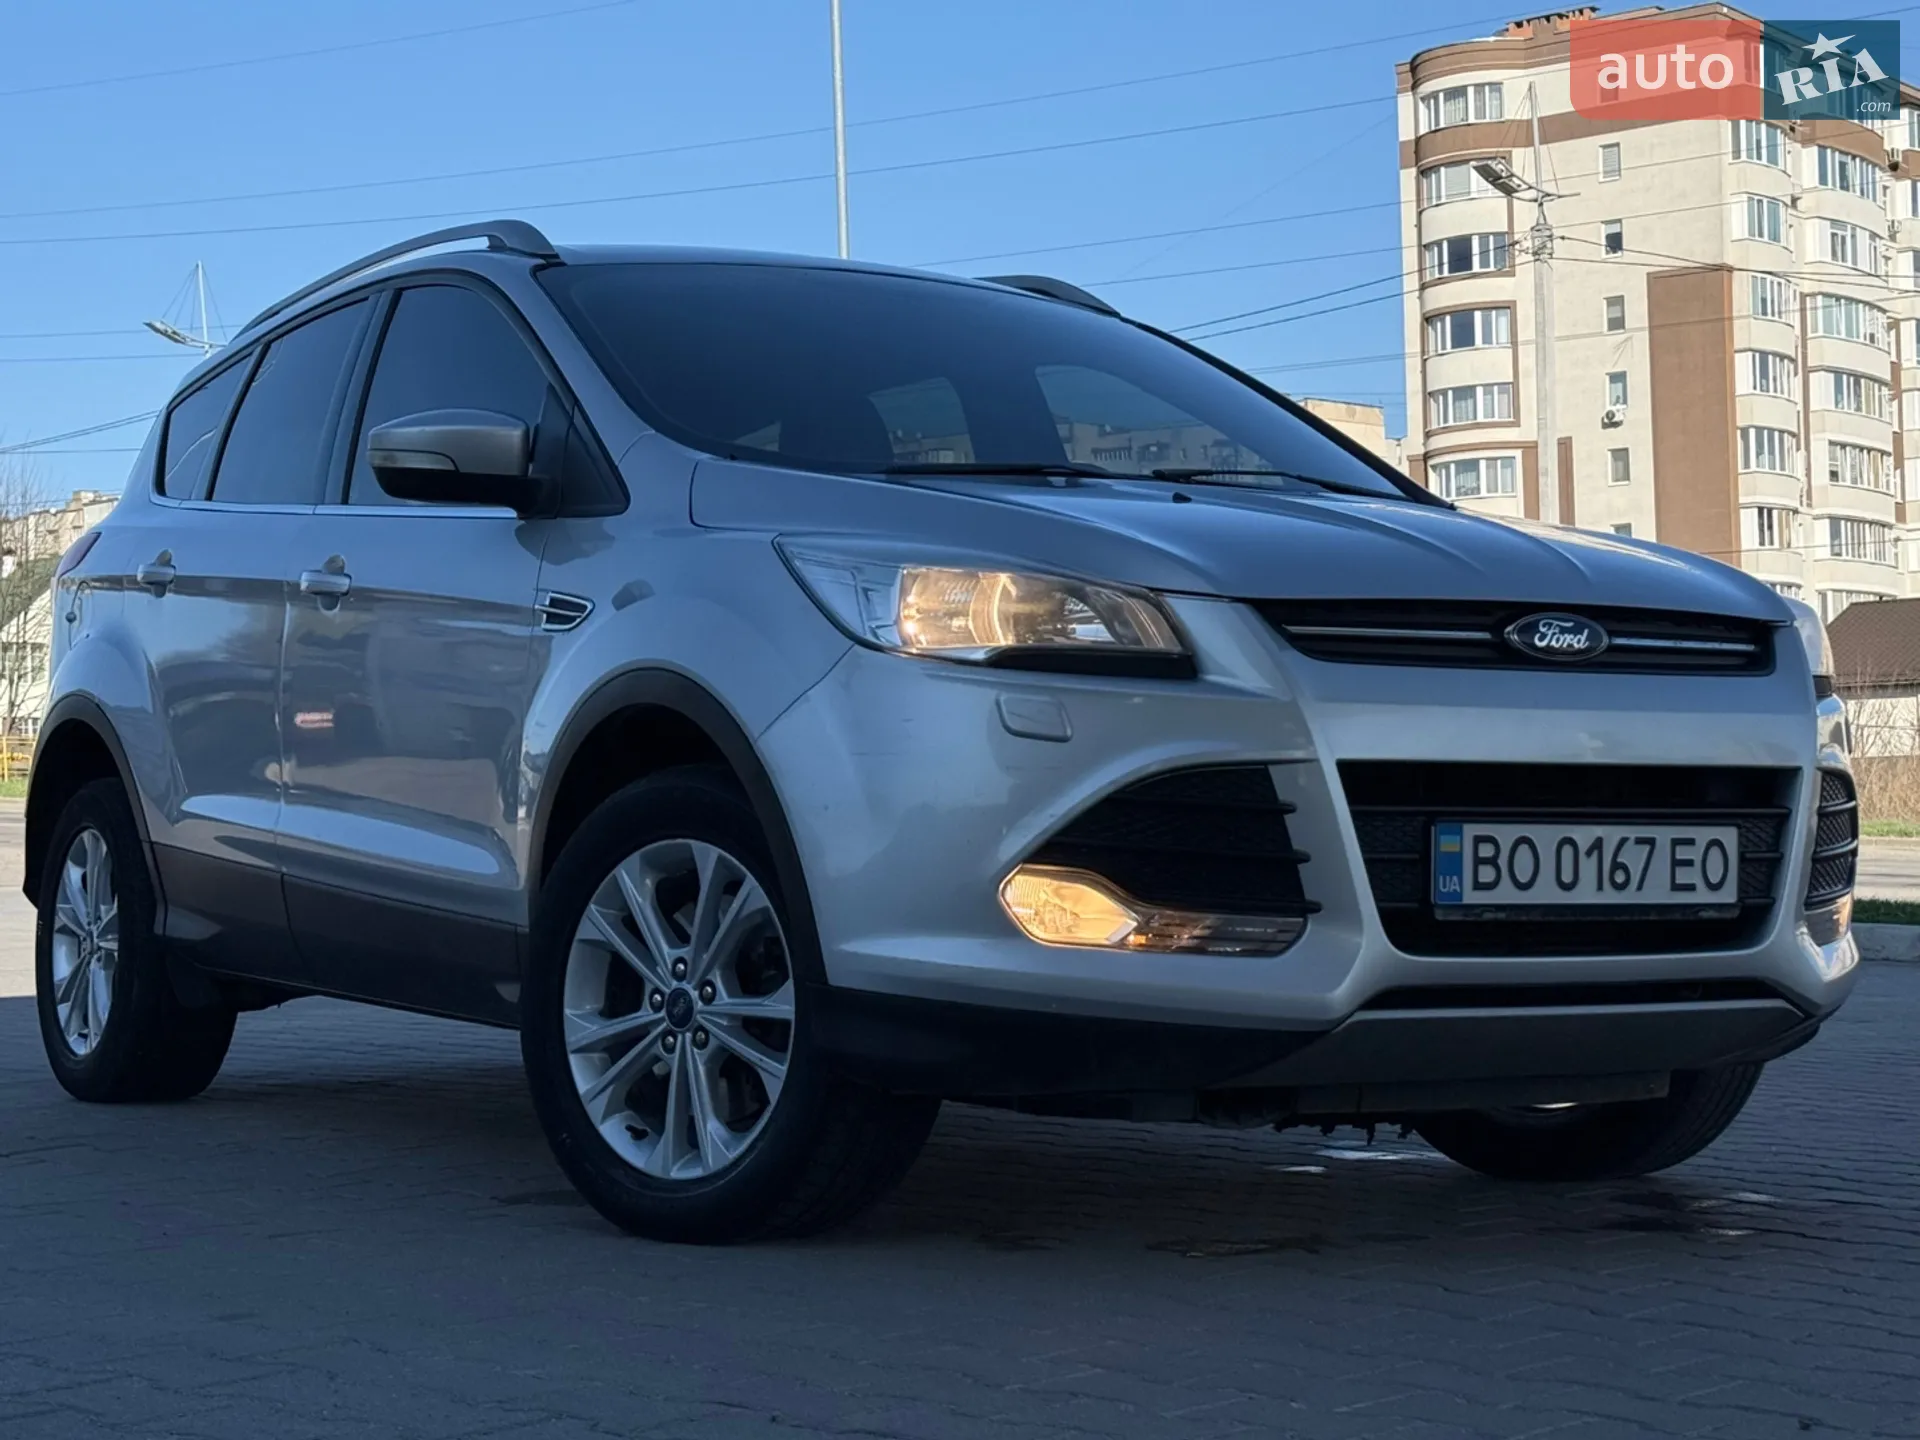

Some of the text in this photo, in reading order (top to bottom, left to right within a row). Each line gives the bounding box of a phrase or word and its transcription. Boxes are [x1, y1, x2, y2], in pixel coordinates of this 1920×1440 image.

[1534, 619, 1589, 649] Ford
[1472, 834, 1729, 893] BO 0167 EO
[1439, 876, 1461, 894] UA
